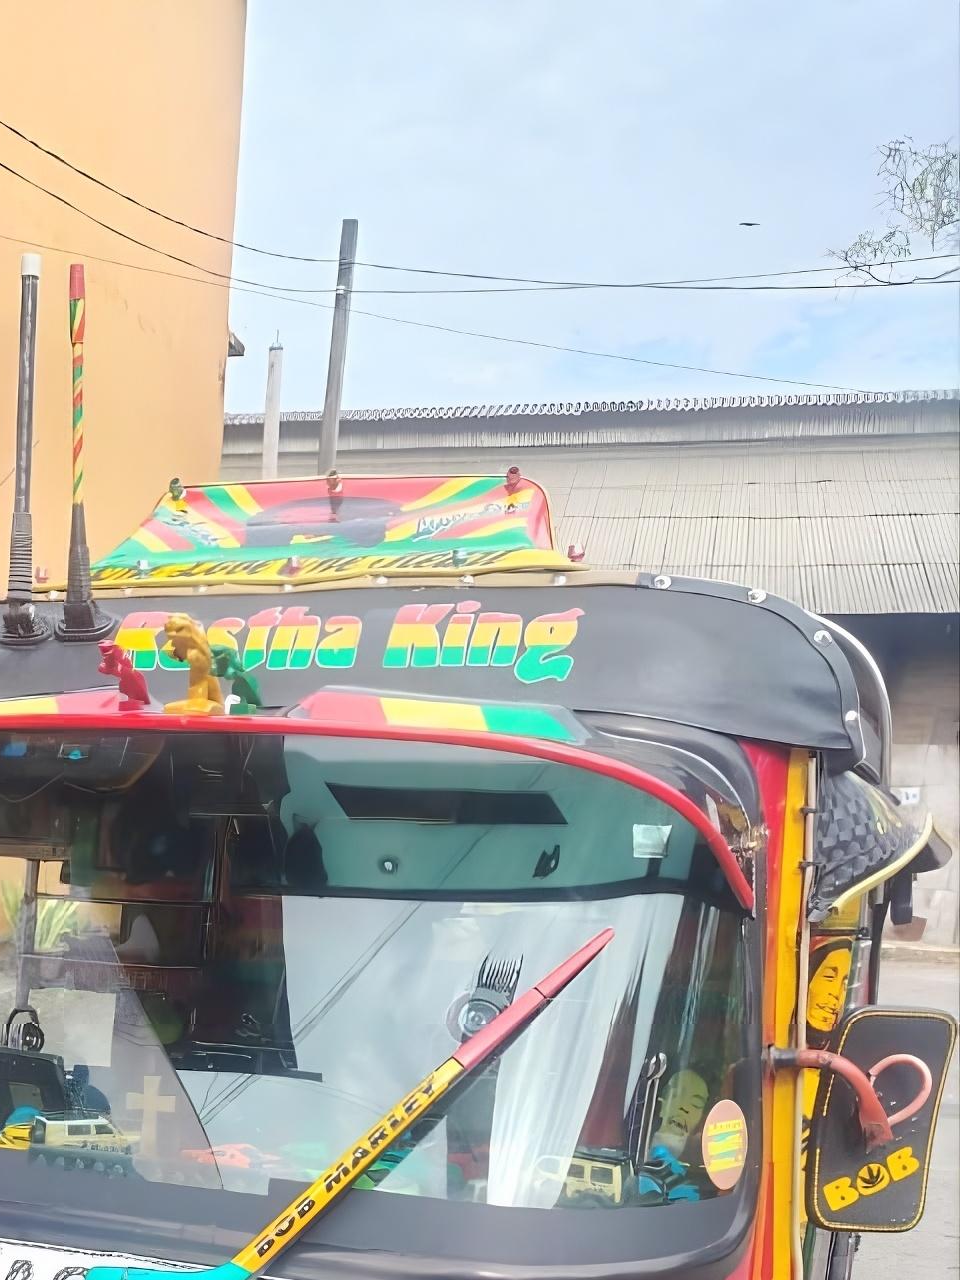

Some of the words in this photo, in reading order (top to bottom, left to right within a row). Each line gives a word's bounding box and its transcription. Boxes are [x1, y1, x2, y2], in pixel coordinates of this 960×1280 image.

[382, 600, 585, 683] King
[822, 1146, 920, 1212] BOB
[254, 1194, 316, 1258] BOB
